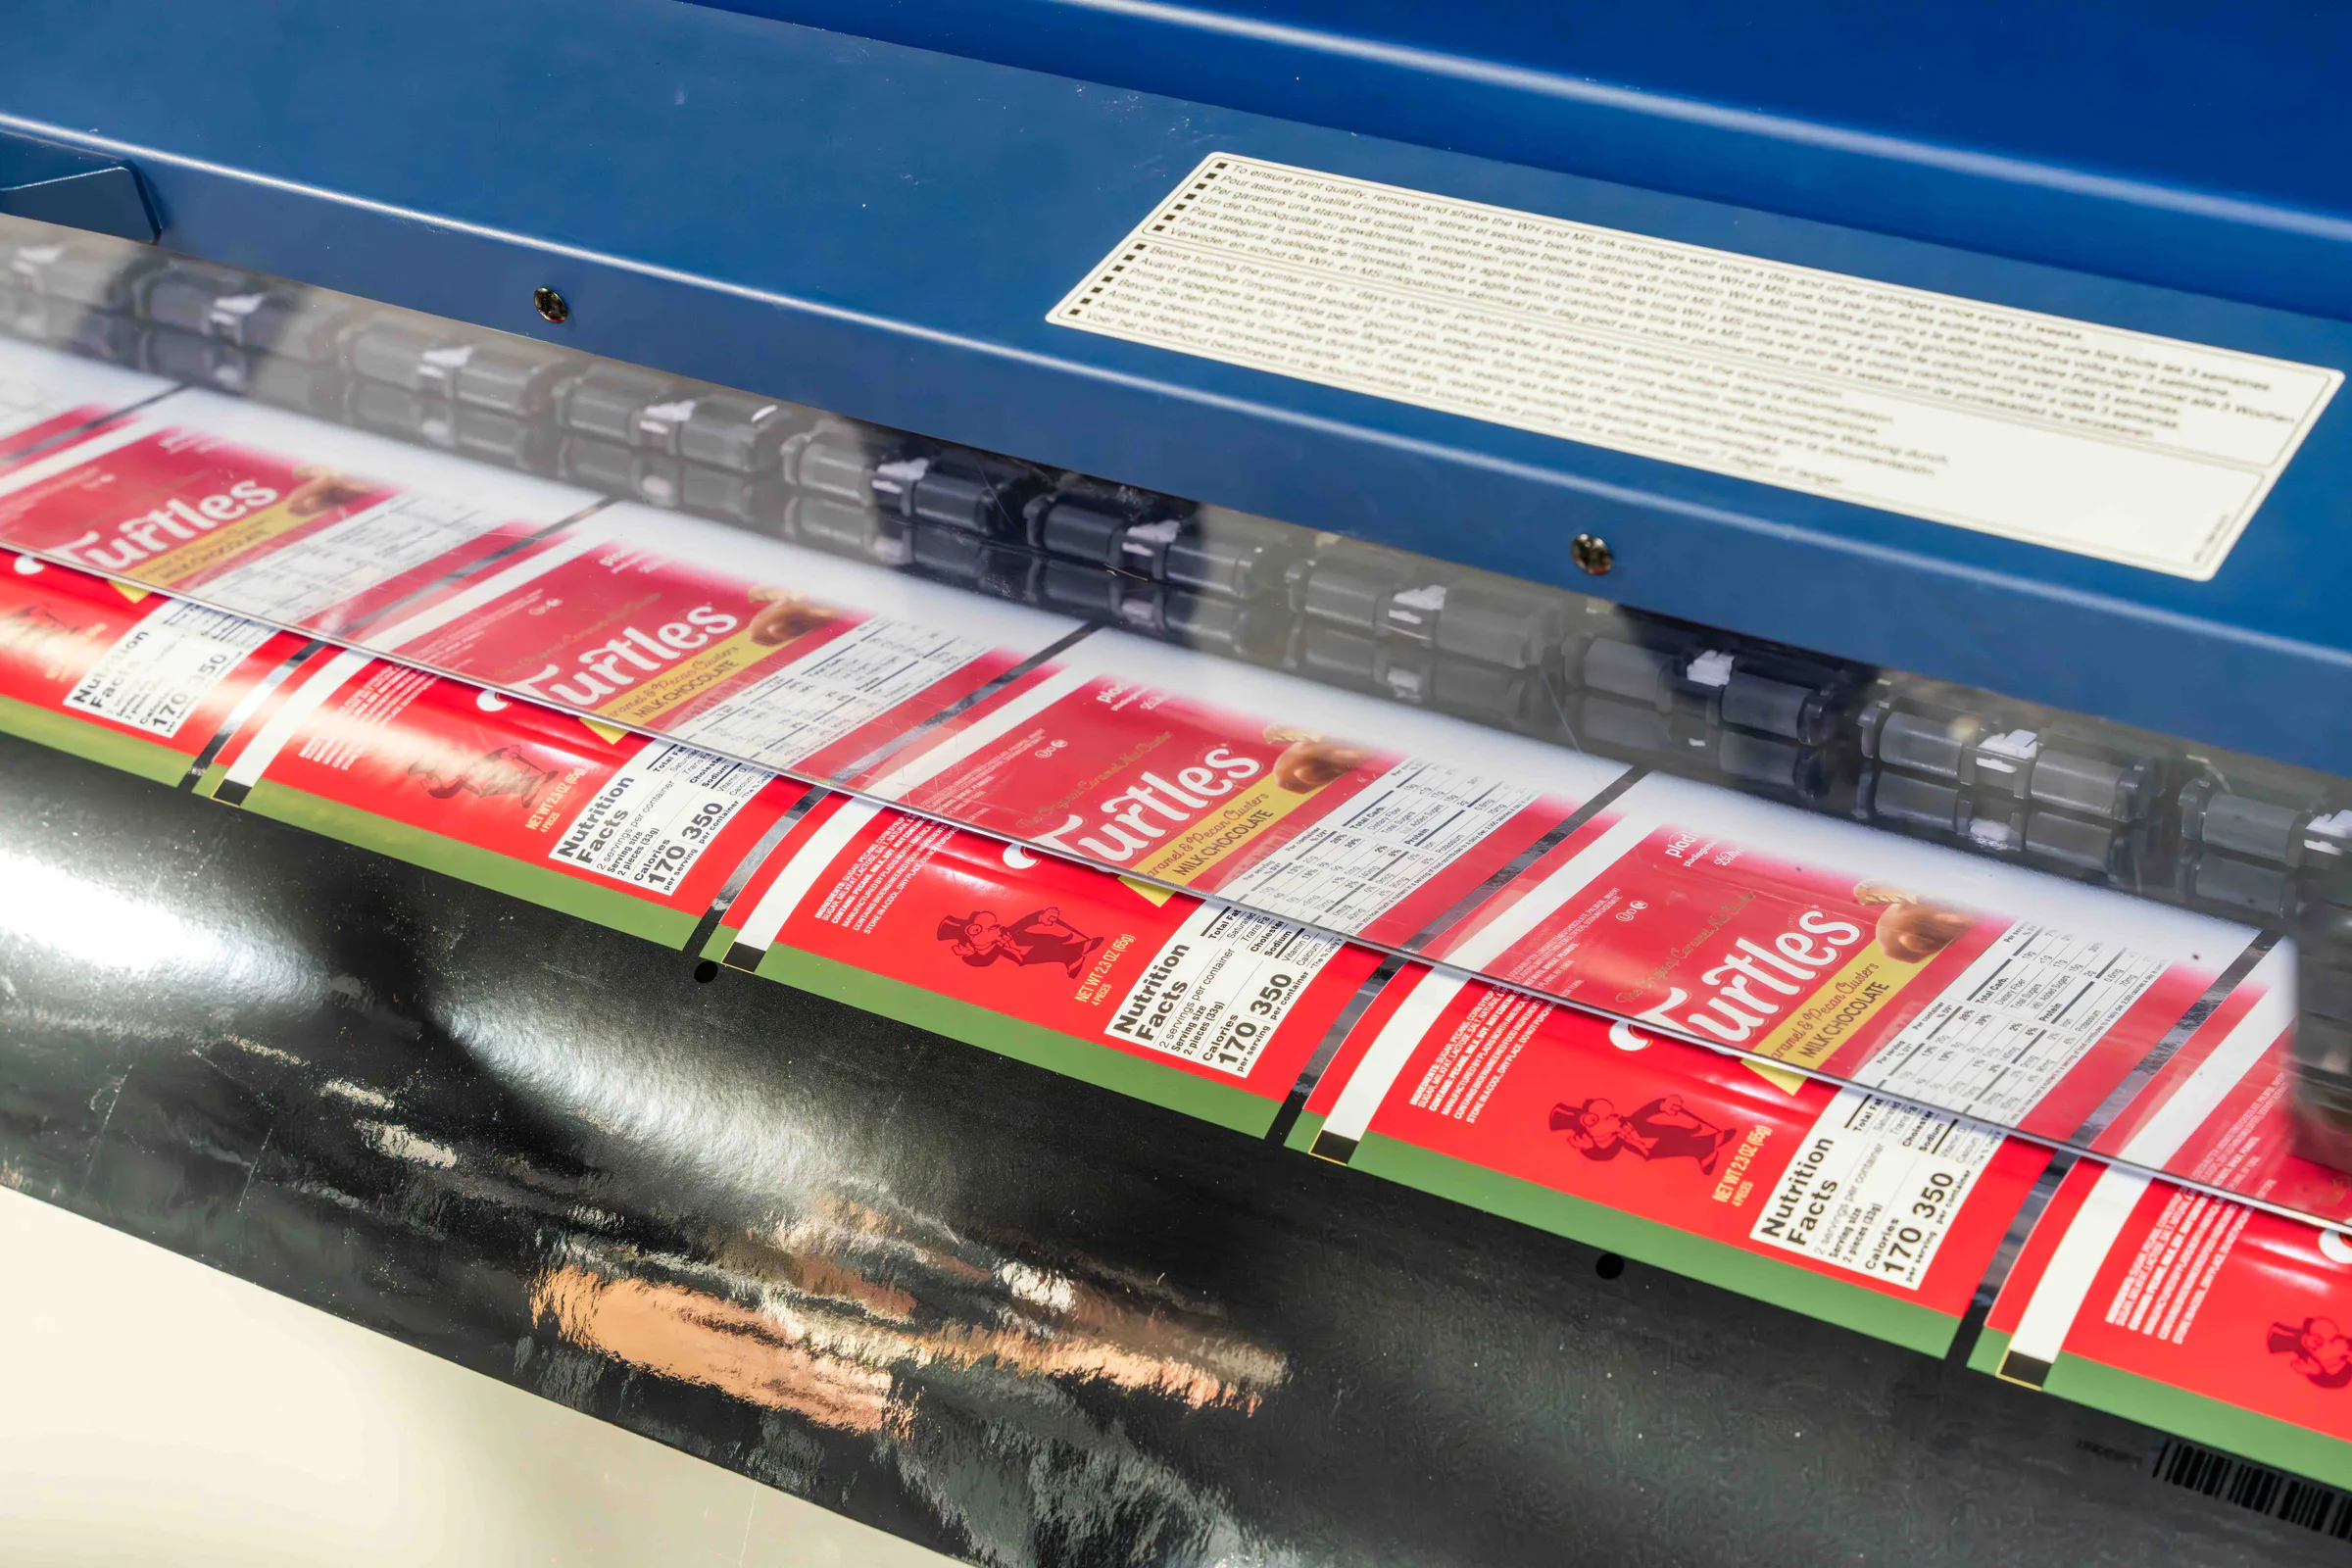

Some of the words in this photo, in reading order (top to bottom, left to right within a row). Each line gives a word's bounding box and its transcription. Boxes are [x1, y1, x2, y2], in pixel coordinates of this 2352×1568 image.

[1201, 195, 1222, 206] Um
[1225, 200, 1243, 210] die
[1212, 185, 1232, 195] Per
[1234, 190, 1288, 208] garantire
[1290, 202, 1310, 212] una
[1313, 206, 1359, 221] stampa
[1222, 174, 1250, 186] Pour
[1253, 182, 1294, 195] assurer
[1312, 193, 1352, 208] qualité
[1233, 165, 1249, 174] To
[1251, 171, 1292, 182] ensure
[1296, 177, 1324, 190] print
[1375, 194, 1420, 208] remove
[1425, 202, 1449, 213] and
[1453, 208, 1491, 221] shake
[1494, 216, 1514, 225] the
[1519, 220, 1543, 231] WH
[1546, 225, 1571, 237] and
[1575, 231, 1596, 242] MS
[1600, 236, 1618, 246] ink
[1169, 226, 1228, 246] Verwijder
[1181, 217, 1208, 228] Para
[1210, 224, 1267, 242] assegurar
[1191, 206, 1218, 218] Para
[1221, 214, 1270, 229] asegurar
[1291, 225, 1333, 241] calidad
[1130, 268, 1166, 281] Prima
[1141, 256, 1177, 270] Avant
[1152, 246, 1192, 261] Before
[1194, 255, 1238, 271] turning
[1242, 265, 1260, 275] the
[1262, 270, 1303, 285] printer
[1307, 278, 1324, 288] off
[14, 479, 278, 574] Turtles
[477, 606, 737, 711] Turtles
[634, 697, 667, 718] MILK
[665, 661, 740, 702] CHOCOLATE
[653, 757, 673, 772] Total
[702, 765, 730, 787] Sodium
[525, 814, 544, 829] NET
[536, 803, 553, 814] WT
[547, 792, 563, 805] 2.3
[556, 782, 570, 793] OZ
[542, 811, 561, 829] PIECES
[557, 777, 634, 858] Nutrition
[604, 828, 632, 861] servings
[631, 813, 642, 827] per
[643, 780, 674, 812] container
[699, 829, 710, 844] per
[710, 801, 739, 831] container
[1003, 747, 1263, 869] Turtles
[1223, 793, 1269, 820] Clusters
[576, 809, 628, 863] Facts
[623, 847, 644, 870] pieces
[641, 827, 660, 845] (33g)
[648, 846, 686, 883] 170
[682, 803, 723, 840] 350
[1172, 855, 1209, 876] MILK
[1200, 809, 1274, 857] CHOCOLATE
[1179, 843, 1194, 852] &
[1186, 819, 1231, 844] Pecan
[608, 846, 632, 873] Serving
[629, 831, 643, 846] size
[634, 839, 670, 881] Calories
[1147, 850, 1185, 876] aramel
[663, 875, 675, 891] per
[674, 849, 698, 875] serving
[842, 884, 876, 927] MANUFACTURED
[882, 857, 900, 878] PLADIS
[895, 843, 913, 860] NORTH
[814, 880, 847, 918] INGREDIENTS:
[853, 902, 876, 931] CONTAINS
[874, 862, 907, 904] BIOENGINEERED
[906, 850, 919, 864] FOOD
[863, 913, 882, 934] STORE
[897, 877, 907, 890] DRY
[831, 895, 857, 924] CONTAINS:
[1208, 921, 1228, 939] Total
[1226, 909, 1241, 921] Fat
[1227, 912, 1256, 939] Saturated
[1111, 934, 1136, 952] (65g)
[1241, 923, 1258, 943] Trans
[1264, 931, 1292, 956] Sodium
[1095, 960, 1112, 973] 2.3
[1103, 951, 1120, 961] OZ
[1282, 941, 1305, 961] Vitamin
[1297, 943, 1321, 966] Calcium
[1075, 985, 1094, 1002] NET
[1085, 972, 1103, 986] WT
[1093, 983, 1111, 1003] PIECES
[1113, 945, 1190, 1034] Nutrition
[1166, 1002, 1195, 1040] servings
[1192, 986, 1205, 1001] per
[1203, 949, 1235, 985] container
[1270, 1007, 1282, 1020] per
[1281, 971, 1308, 1005] container
[1608, 909, 1864, 1054] Turtles
[1836, 963, 1880, 994] Clusters
[1135, 981, 1188, 1041] Facts
[1802, 994, 1846, 1021] Pecan
[1976, 989, 1994, 1004] Total
[2038, 1003, 2062, 1022] Protein
[1171, 1021, 1197, 1051] Serving
[1193, 1005, 1206, 1021] size
[1190, 1021, 1210, 1049] pieces
[1205, 1002, 1225, 1021] (33g)
[1218, 1022, 1256, 1063] 170
[1250, 974, 1292, 1015] 350
[1797, 1020, 1813, 1030] &
[1798, 1034, 1835, 1058] MILK
[1822, 981, 1890, 1035] CHOCOLATE
[1202, 1014, 1238, 1061] Calories
[1237, 1057, 1249, 1072] per
[1247, 1025, 1271, 1055] serving
[1771, 1029, 1806, 1058] aramel
[1739, 1143, 1758, 1156] OZ
[1746, 1125, 1773, 1146] (65g)
[1723, 1168, 1742, 1185] WT
[1731, 1155, 1750, 1171] 2.3
[1712, 1183, 1734, 1202] NET
[1761, 1139, 1834, 1238] Nutrition
[1787, 1180, 1838, 1246] Facts
[1884, 1228, 1922, 1273] 170
[1913, 1173, 1953, 1218] 350
[1829, 1226, 1853, 1258] Serving
[1865, 1219, 1898, 1269] Calories
